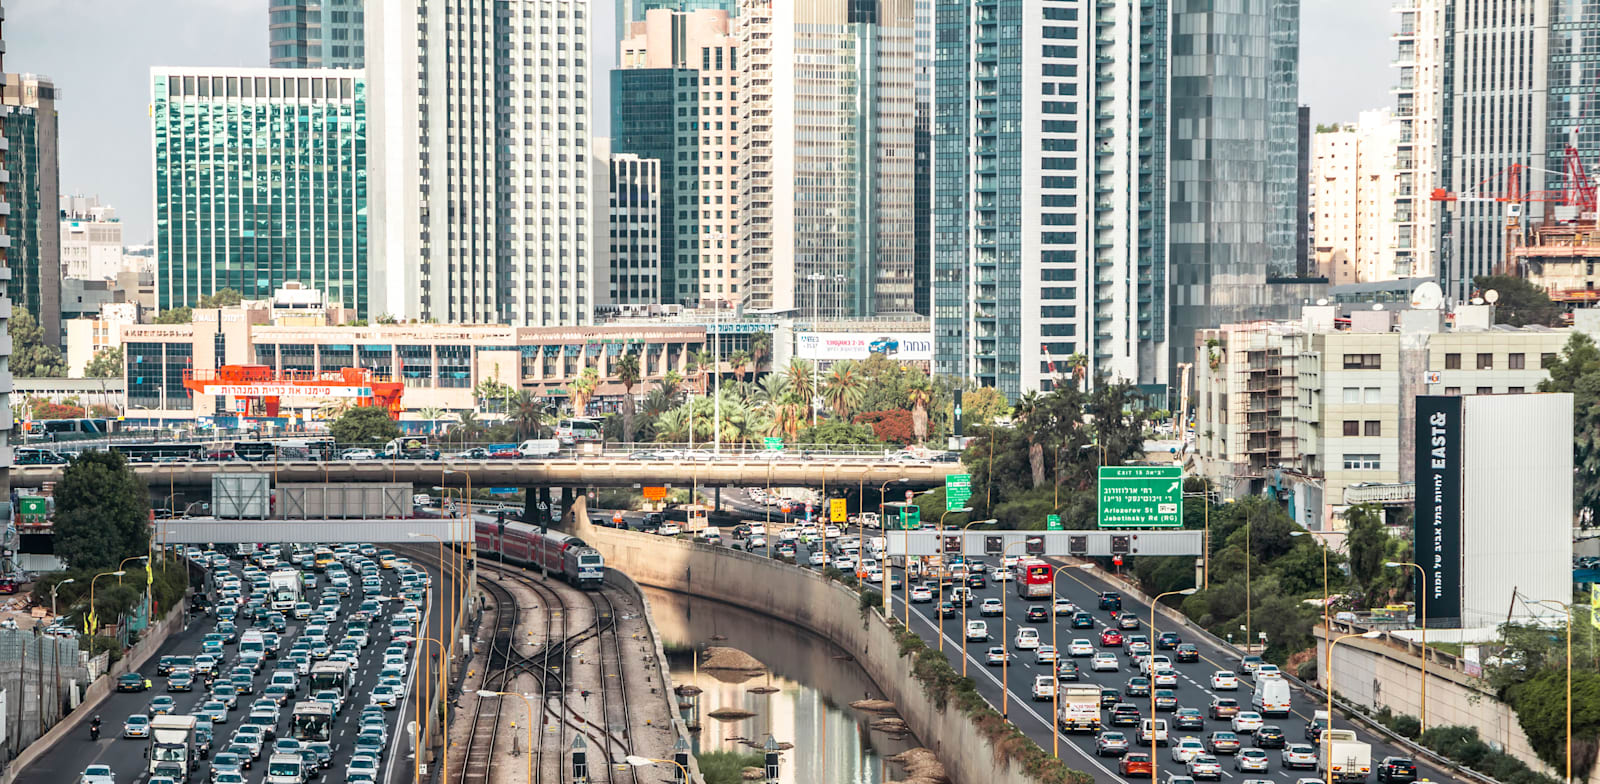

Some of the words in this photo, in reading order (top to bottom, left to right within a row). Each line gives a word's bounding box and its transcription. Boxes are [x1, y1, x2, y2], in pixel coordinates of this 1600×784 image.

[903, 340, 931, 352] הנחה!
[221, 386, 259, 395] המנהרות
[262, 387, 286, 396] כריית
[288, 387, 301, 395] את
[1430, 412, 1447, 469] EAST&
[1433, 473, 1443, 503] לחיות
[1433, 504, 1443, 526] בתל
[1433, 527, 1443, 552] אביב
[1433, 554, 1443, 569] של
[1433, 571, 1443, 600] המחר
